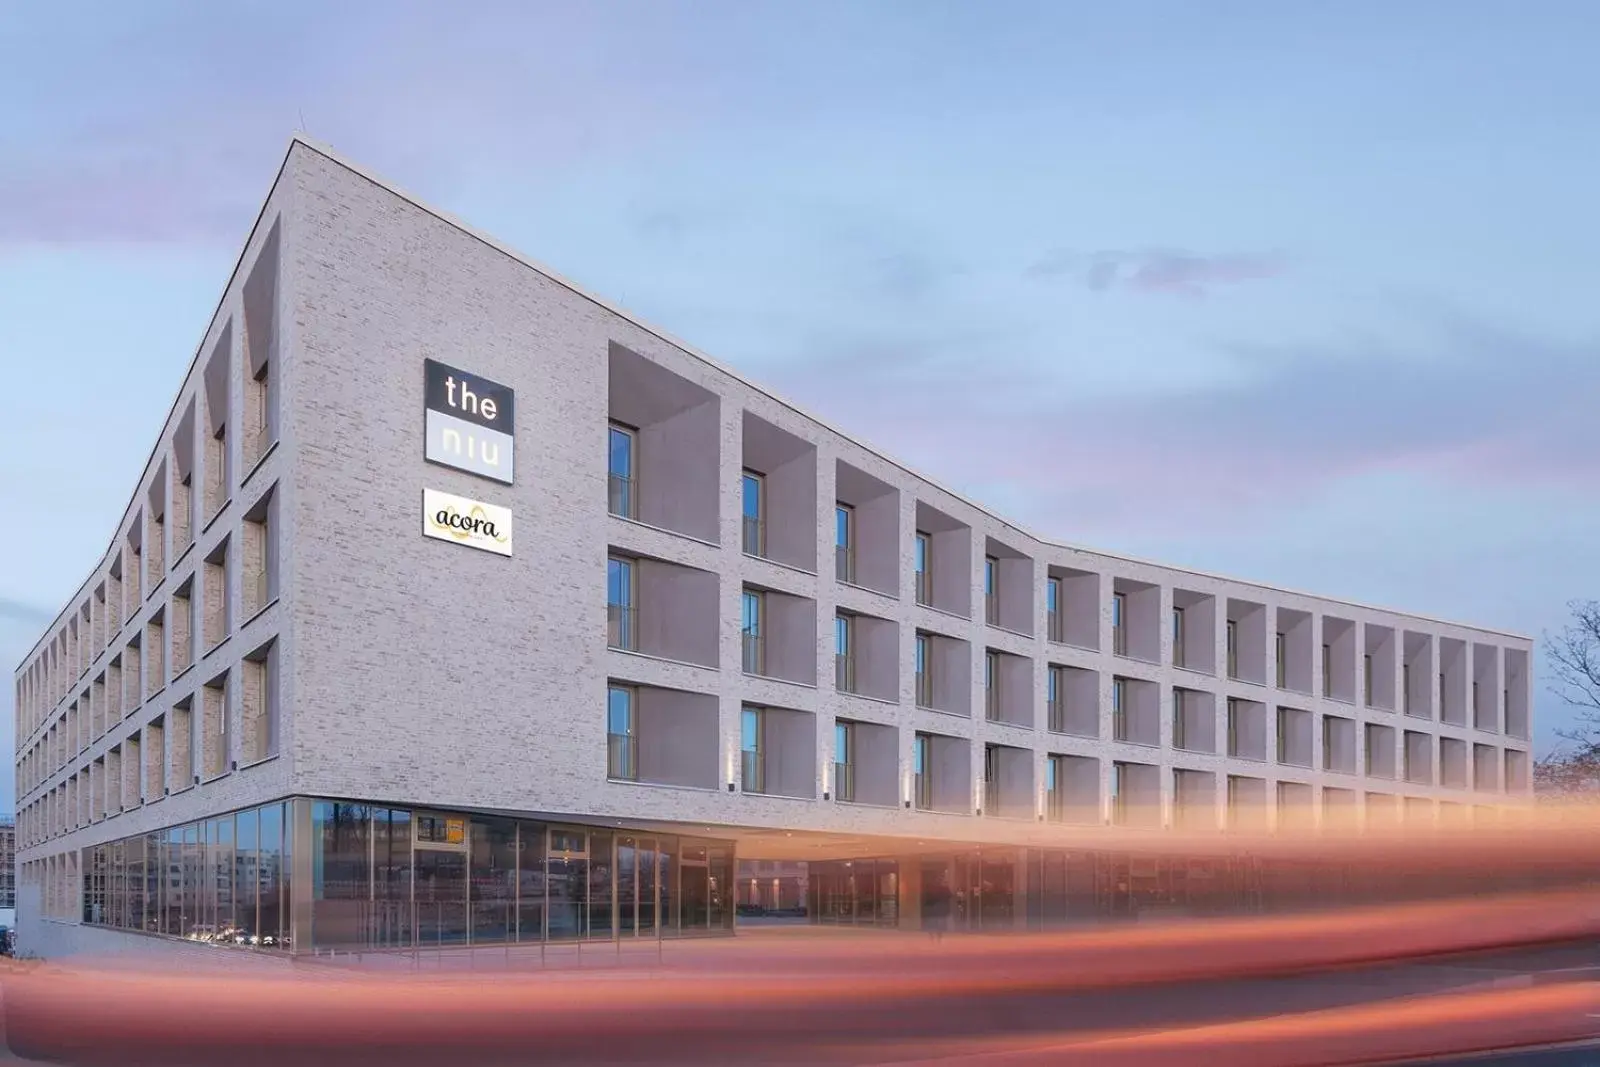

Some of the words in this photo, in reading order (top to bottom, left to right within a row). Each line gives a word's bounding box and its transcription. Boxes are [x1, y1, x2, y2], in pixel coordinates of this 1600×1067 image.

[445, 376, 497, 420] the
[443, 427, 499, 466] niu
[436, 510, 500, 538] acora
